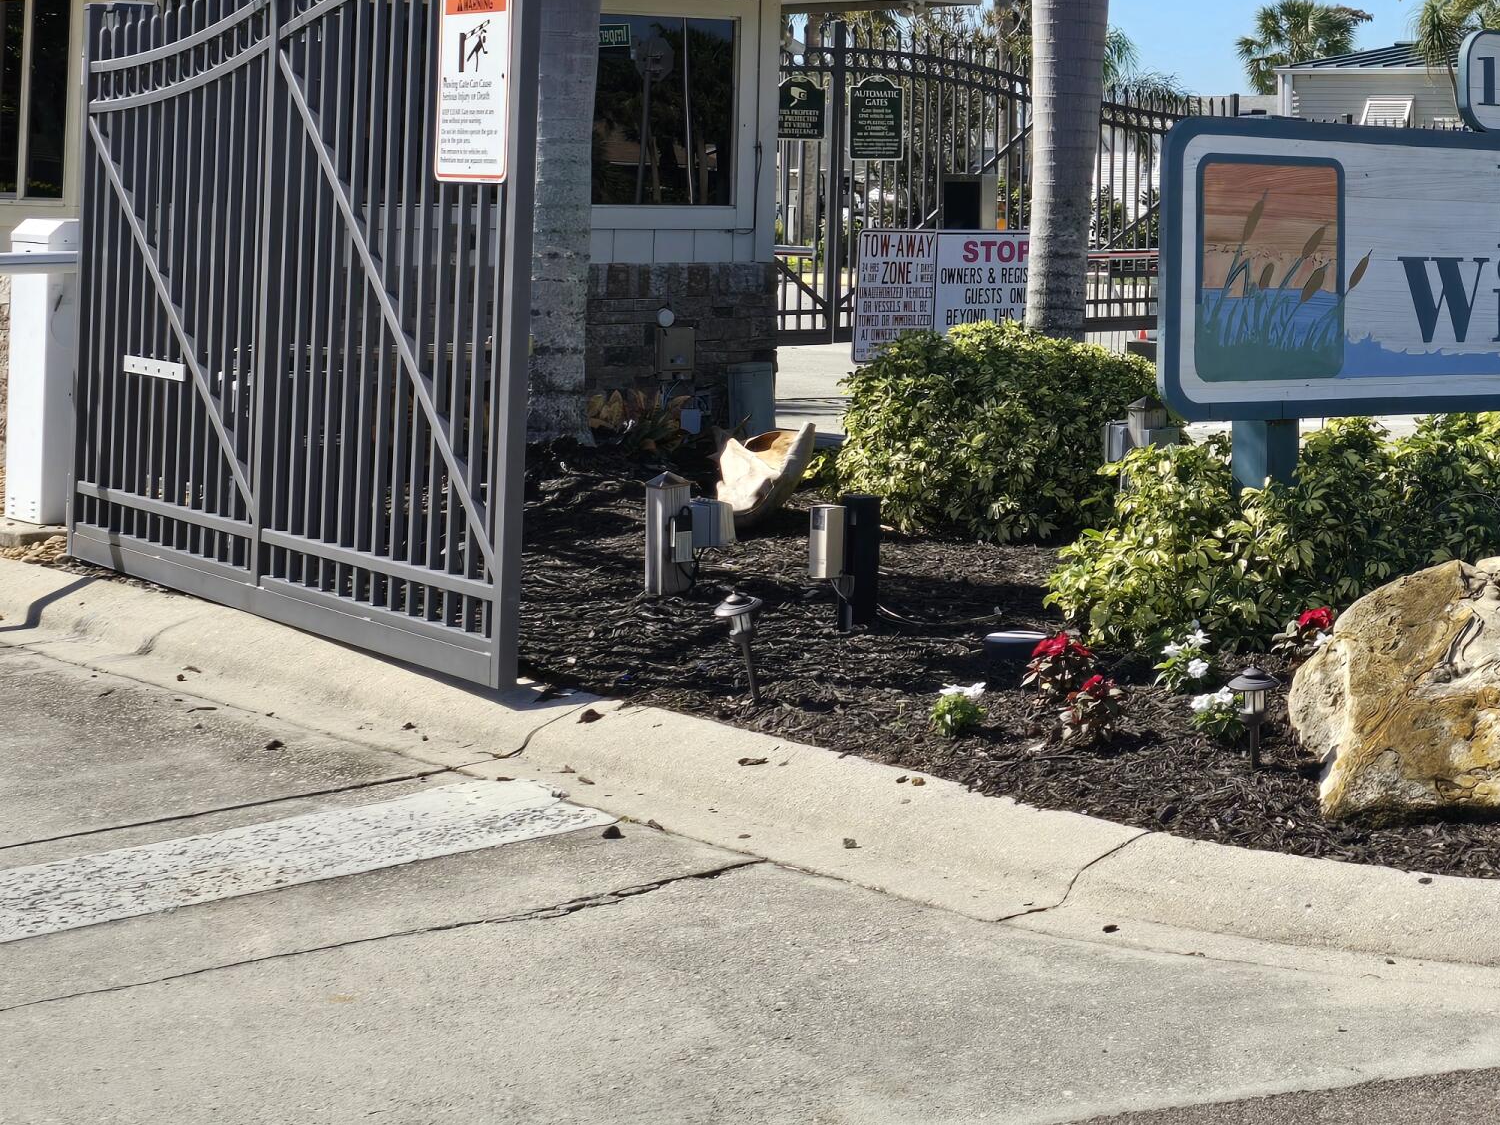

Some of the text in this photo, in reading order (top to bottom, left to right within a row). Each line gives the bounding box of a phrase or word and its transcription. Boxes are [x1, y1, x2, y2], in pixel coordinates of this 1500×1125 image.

[854, 90, 899, 98] AUTOMATIC
[865, 98, 888, 106] GATES
[864, 234, 934, 258] TOW-AWAY
[963, 240, 1030, 263] STOP
[862, 262, 879, 273] 24 HRS
[881, 262, 913, 285] ZONE
[920, 263, 934, 273] DAYS
[868, 273, 877, 283] DAY
[920, 274, 933, 283] WEEK
[941, 267, 1028, 284] OWNERS & REGIS
[859, 286, 933, 299] UNAUTHORIZED VEHICLES
[965, 288, 1028, 305] GUESTS ONL
[863, 300, 928, 313] OR VESSELS WILL BE
[858, 314, 932, 327] TOWED OR IMMOBILIZED
[946, 308, 987, 326] BEYOND
[993, 307, 1015, 324] THIS
[860, 328, 868, 341] AT
